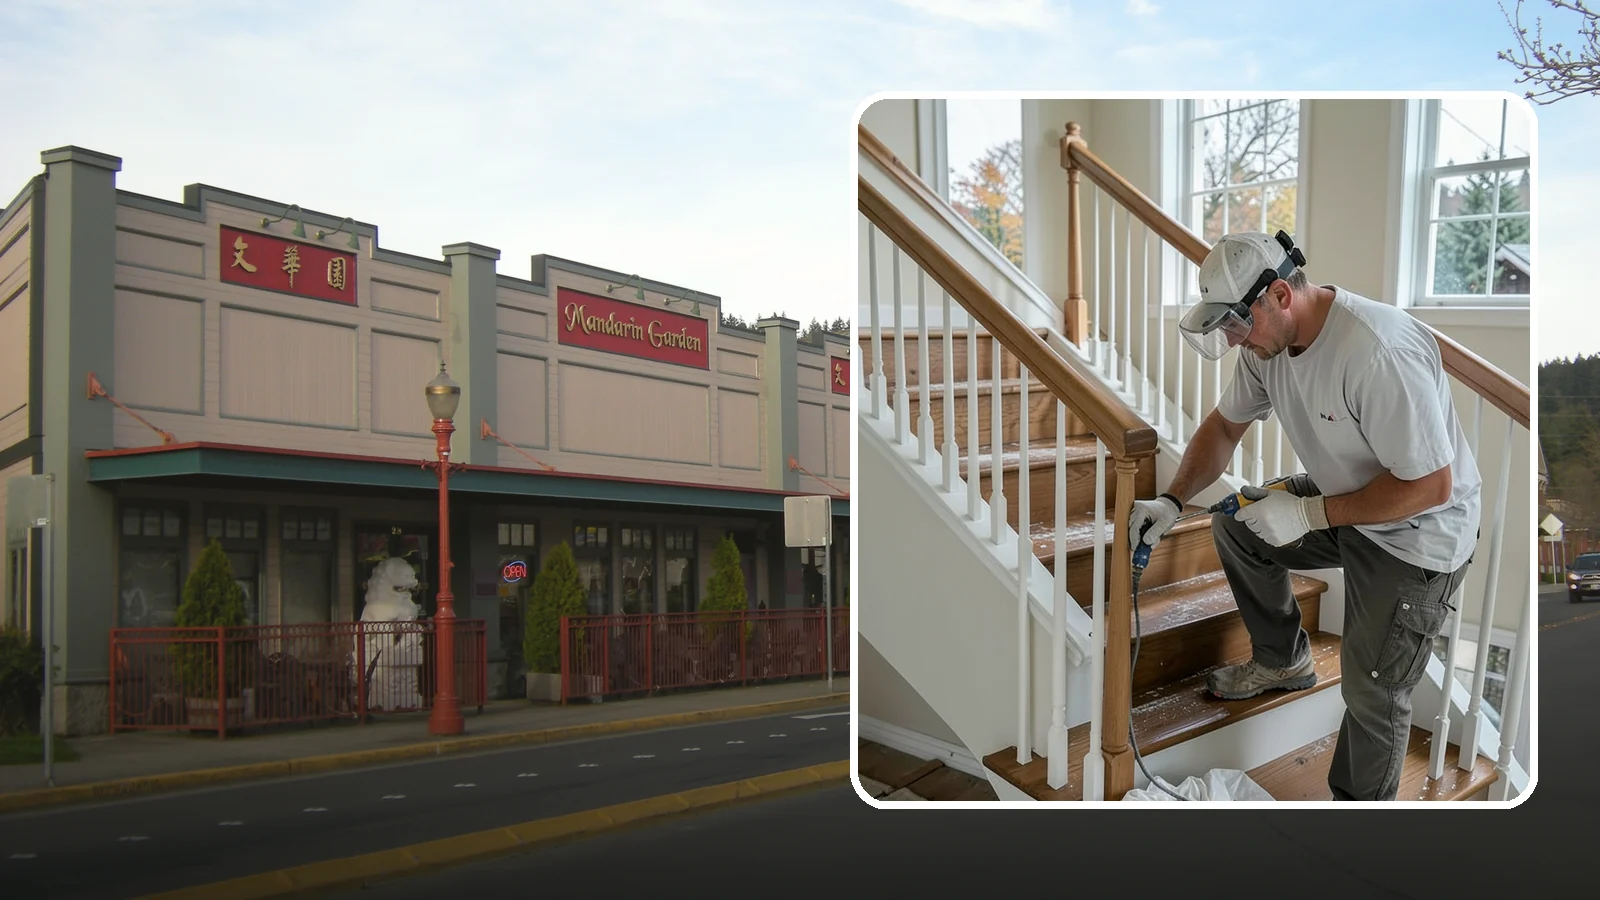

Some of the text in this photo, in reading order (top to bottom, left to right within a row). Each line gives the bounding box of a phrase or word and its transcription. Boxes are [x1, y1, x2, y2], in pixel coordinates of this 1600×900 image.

[230, 235, 347, 291] 文華園
[564, 302, 702, 352] Mandarin Garden
[503, 565, 527, 578] OPEN
